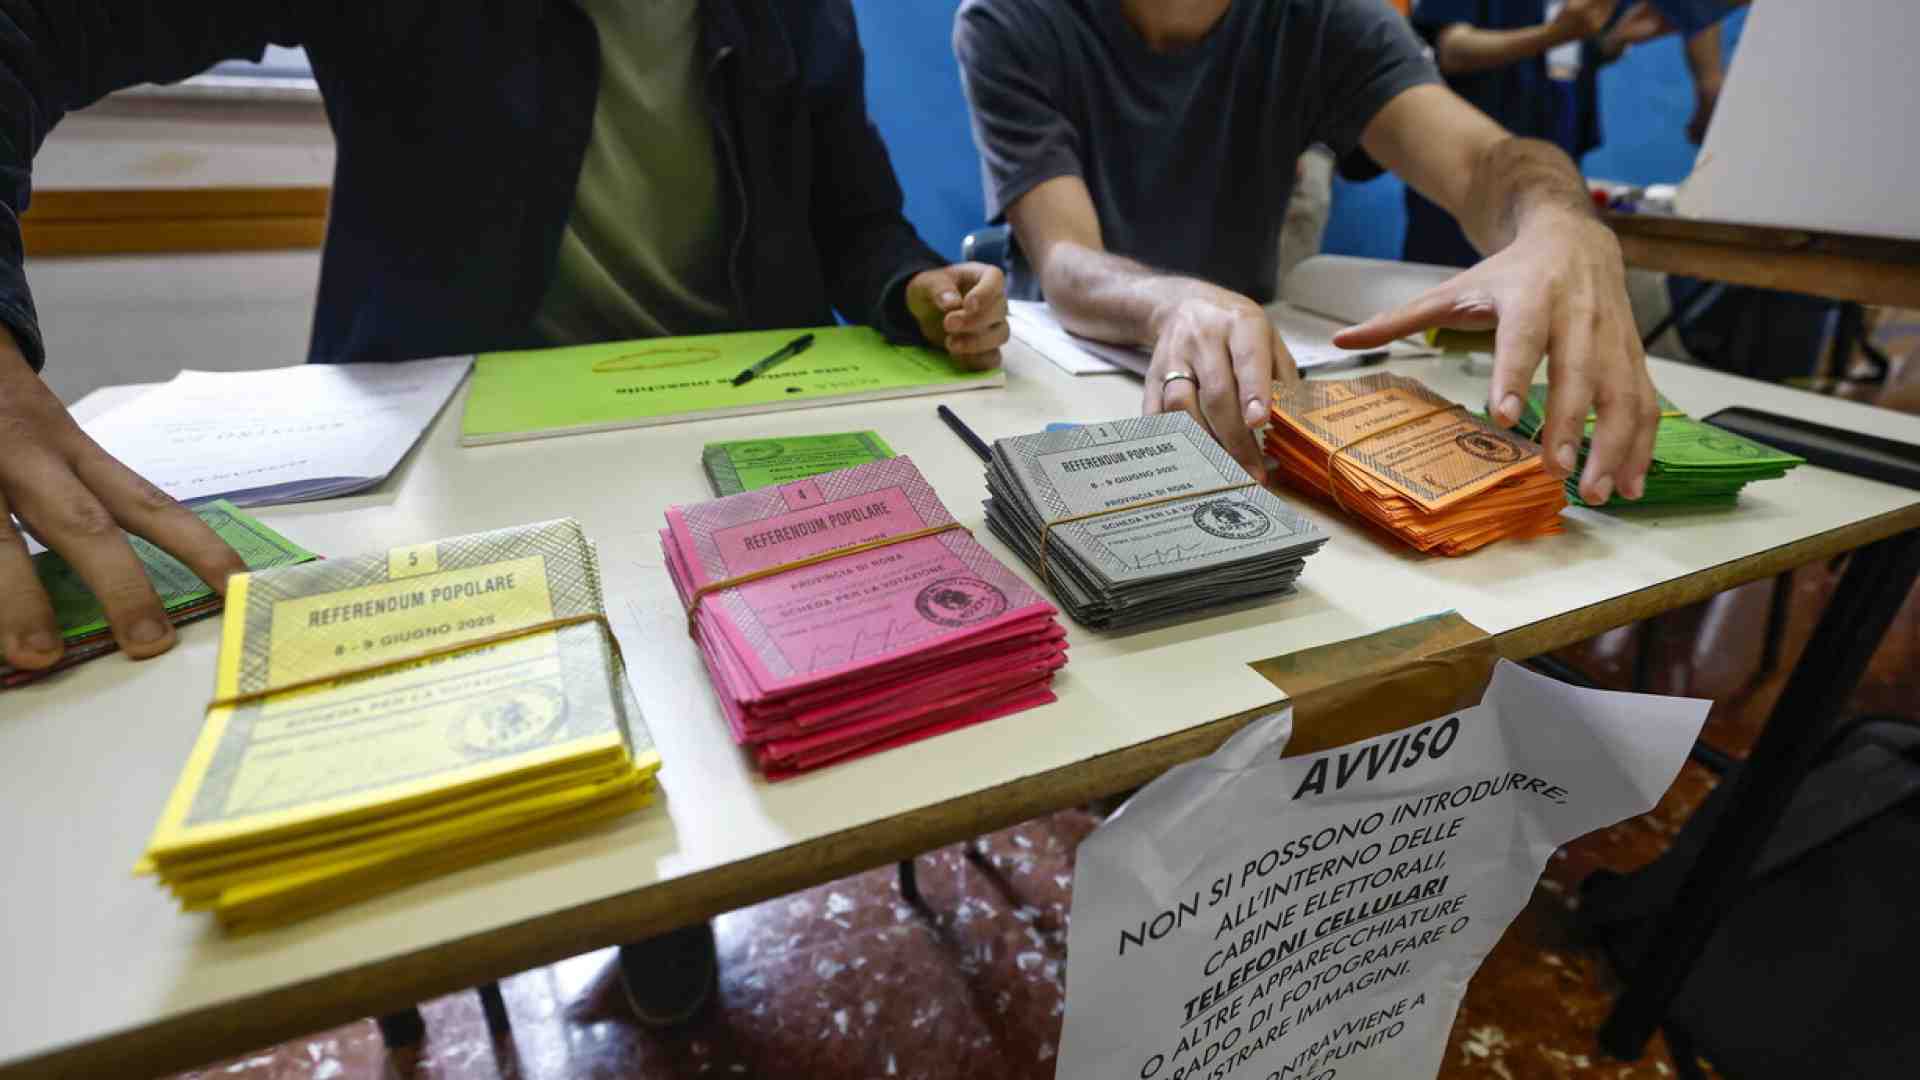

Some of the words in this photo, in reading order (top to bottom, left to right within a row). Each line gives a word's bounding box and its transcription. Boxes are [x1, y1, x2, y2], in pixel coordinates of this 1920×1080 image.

[1060, 451, 1128, 473] REFERENDUM
[1126, 441, 1177, 461] POPOLARE
[409, 551, 419, 567] 5
[743, 517, 828, 551] REFERENDUM
[828, 501, 892, 529] POPOLARE
[308, 591, 425, 628] REFERENDUM
[431, 573, 516, 604] POPOLARE
[379, 623, 452, 647] GIUGNO
[457, 614, 497, 631] 2025
[1292, 717, 1461, 800] AVVISO
[1118, 891, 1200, 956] NON
[1208, 872, 1233, 907] SI
[1240, 811, 1385, 889] POSSONO
[1213, 843, 1382, 941] ALL'INTERNO
[1388, 816, 1465, 857] DELLE
[1203, 903, 1299, 977] CABINE
[1303, 850, 1447, 917] ELETTORALI,
[1183, 928, 1308, 1021] TELEFONI
[1314, 875, 1449, 938] CELLULARI
[1141, 1053, 1165, 1080] O
[1171, 995, 1243, 1062] ALTRE
[1247, 894, 1468, 1007] APPARECCHIATURE
[1164, 1026, 1241, 1080] RADO
[1248, 1001, 1274, 1034] DI
[1280, 924, 1447, 1013] FOTOGRAFARE
[1449, 915, 1471, 936] O
[1296, 959, 1412, 1026] IMMAGINI.
[1409, 992, 1426, 1011] A
[1322, 1020, 1405, 1066] PUNITO
